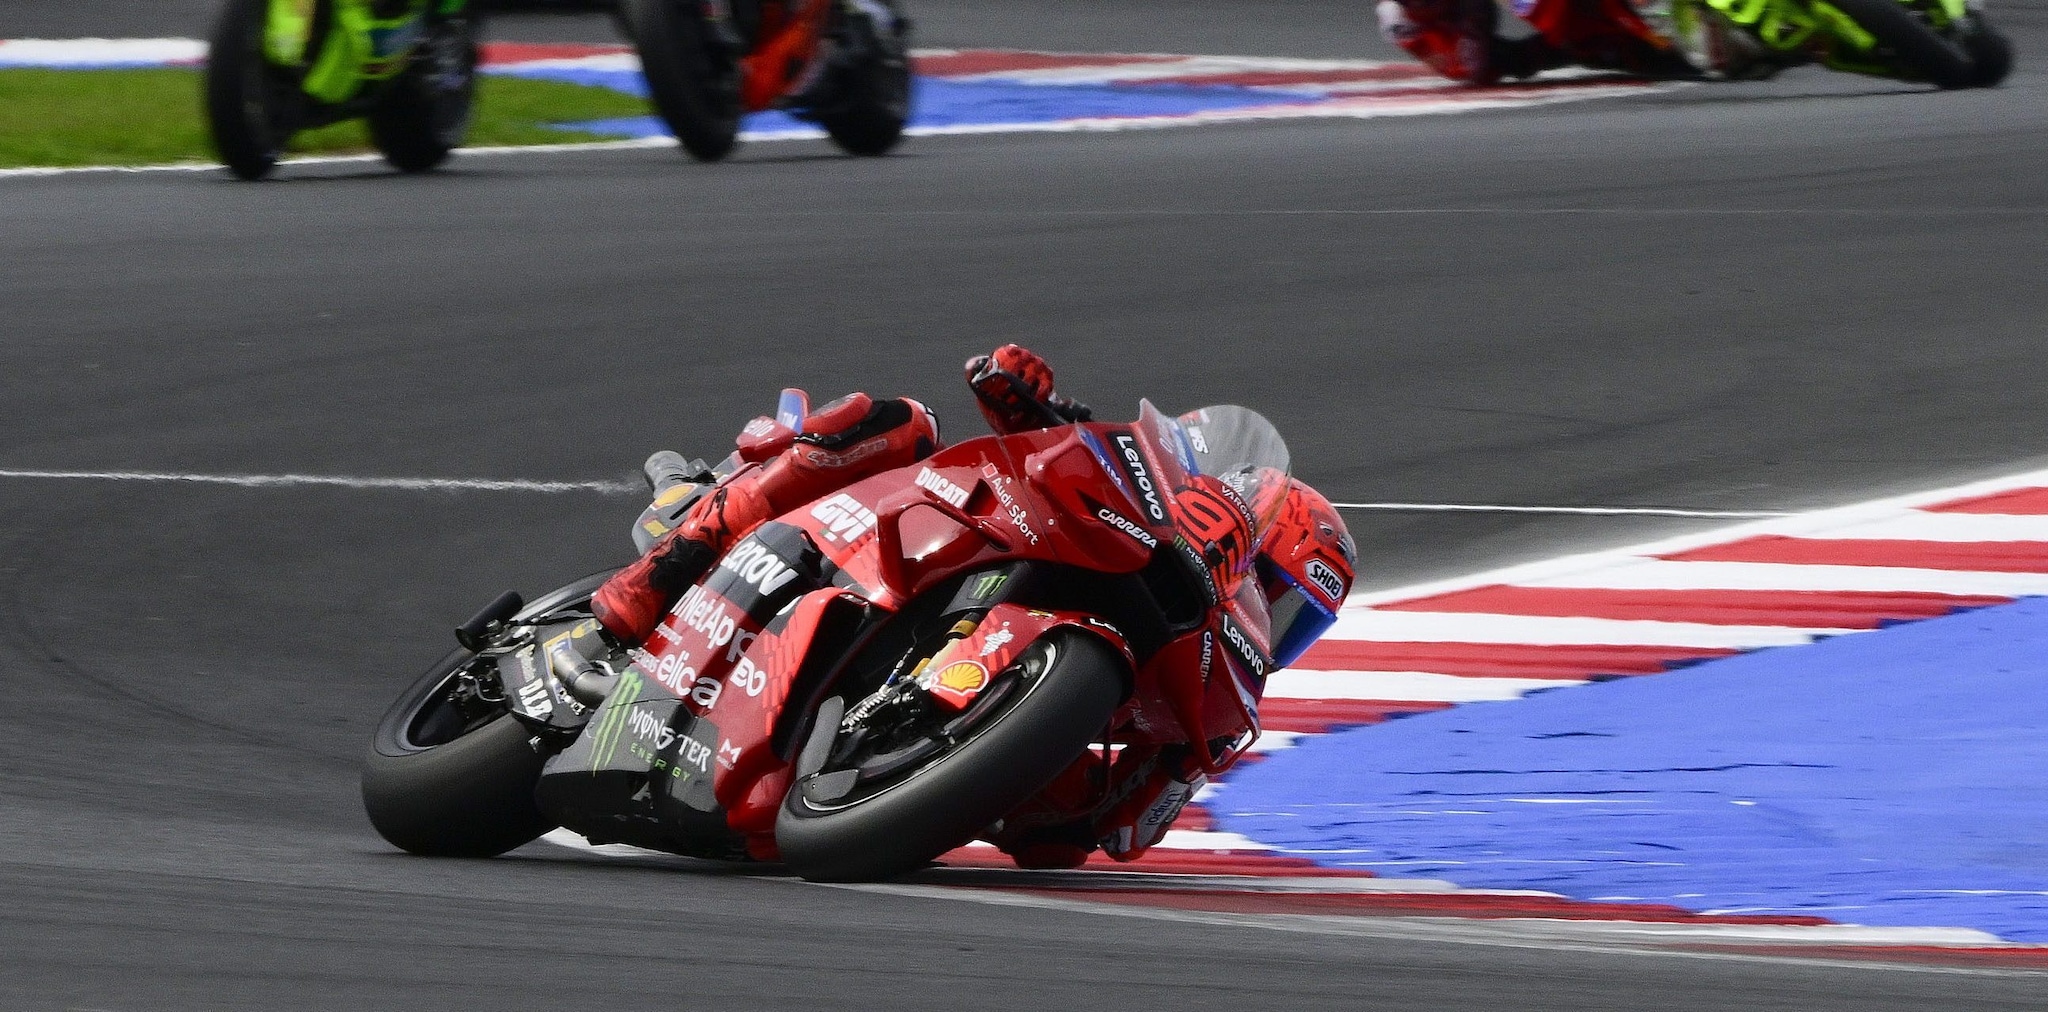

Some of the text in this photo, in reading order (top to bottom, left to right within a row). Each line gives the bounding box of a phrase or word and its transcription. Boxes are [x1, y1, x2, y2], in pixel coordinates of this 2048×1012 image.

[914, 466, 970, 509] DUCATI
[1099, 454, 1122, 486] TIM
[1116, 435, 1163, 520] Lenovo
[810, 493, 878, 543] GIVI
[992, 477, 1039, 546] Audi Sport
[1098, 508, 1157, 549] CARRERA
[1310, 564, 1342, 598] SHOEI
[1223, 614, 1264, 676] Lenovo
[657, 650, 723, 710] elica
[630, 742, 691, 781] ENERGY
